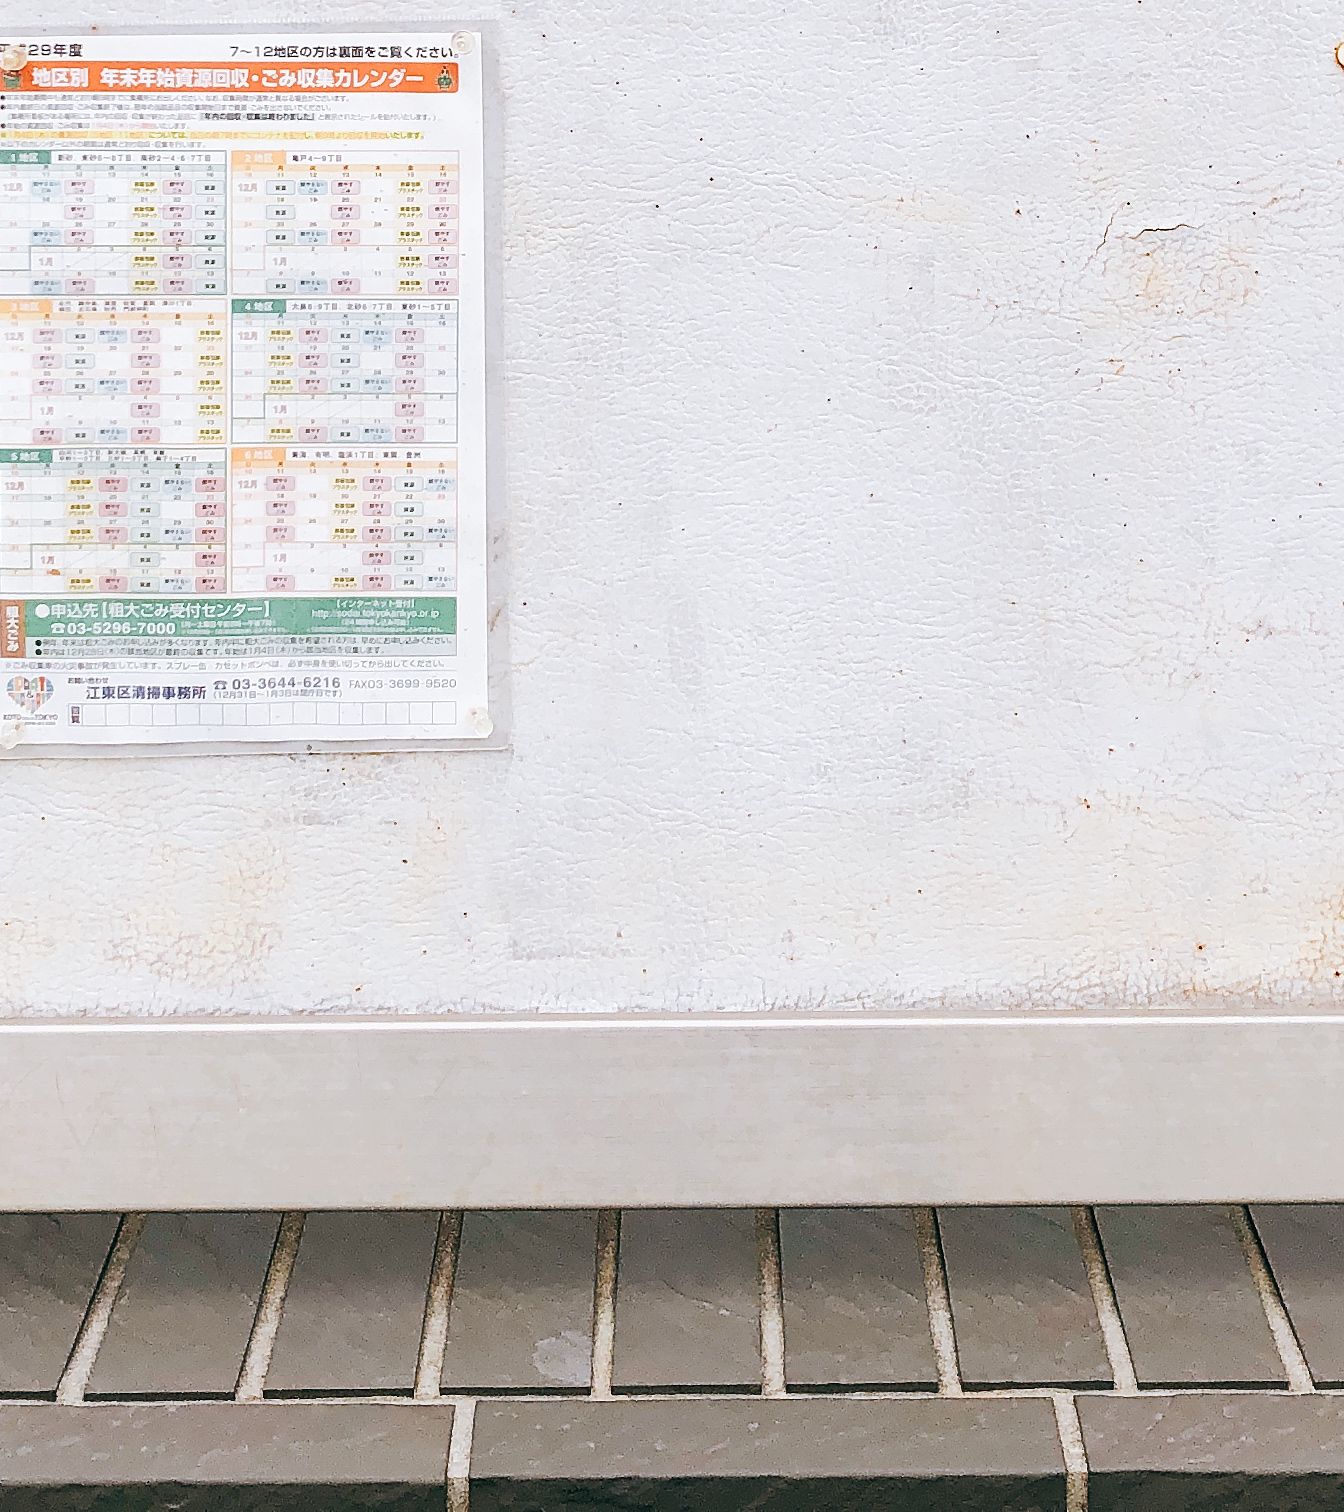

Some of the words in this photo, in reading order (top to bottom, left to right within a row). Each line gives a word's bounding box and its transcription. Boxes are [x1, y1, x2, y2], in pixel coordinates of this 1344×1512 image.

[32, 67, 89, 88] 地区別
[100, 66, 424, 89] 年末年始資源回収・ごみ収集カレンダー
[68, 622, 176, 635] 03-5296-7000
[86, 685, 207, 700] 江東区清掃事務所
[232, 676, 341, 689] 03-3644-6216
